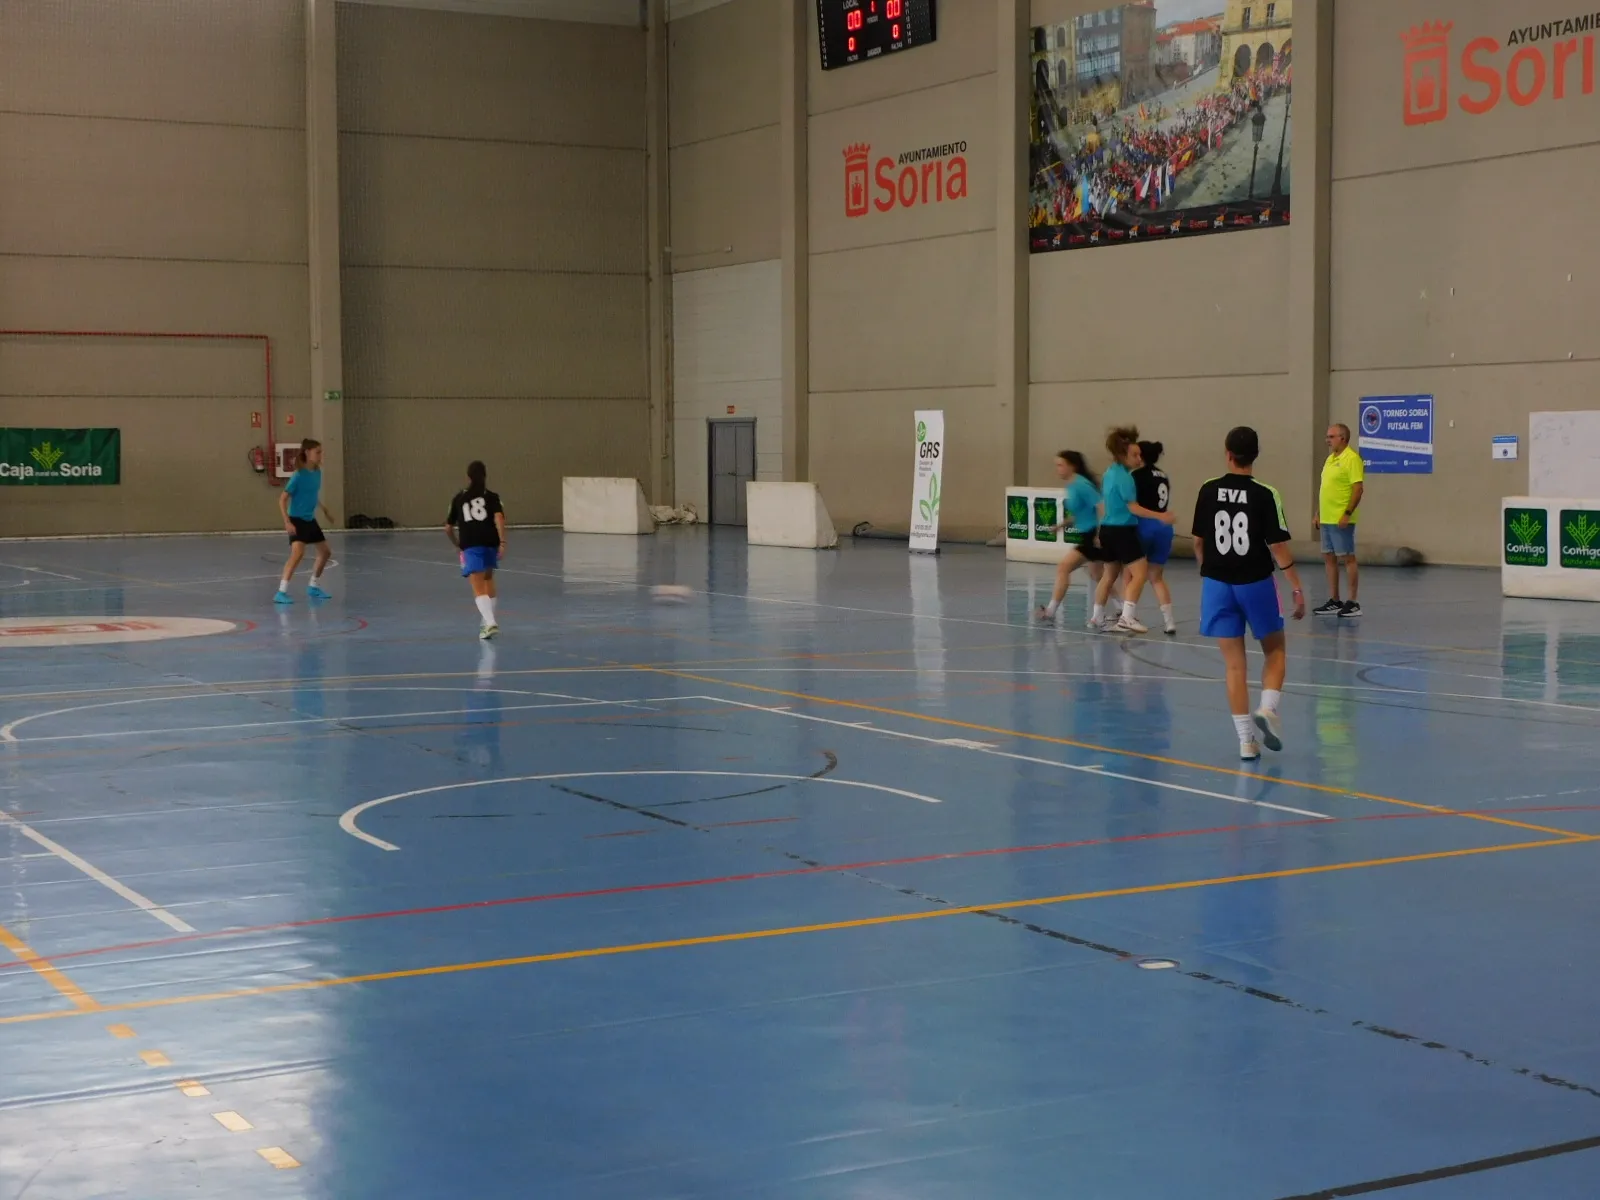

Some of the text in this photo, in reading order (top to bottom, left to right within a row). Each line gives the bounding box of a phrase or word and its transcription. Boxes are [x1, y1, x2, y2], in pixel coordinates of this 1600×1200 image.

[847, 9, 862, 30] 00
[893, 24, 899, 39] 0
[848, 37, 855, 51] 0
[898, 141, 967, 165] AYUNTAMIENTO
[873, 156, 967, 213] Soria
[1382, 409, 1429, 417] TORNEO SORIA
[1387, 422, 1424, 431] FUTSAL FEM
[919, 441, 940, 459] GRS
[0, 462, 34, 480] Caja
[60, 462, 102, 477] Soria
[1217, 487, 1248, 504] EVA
[462, 496, 488, 522] 18
[1214, 509, 1250, 556] 88
[1506, 543, 1546, 557] Contigo
